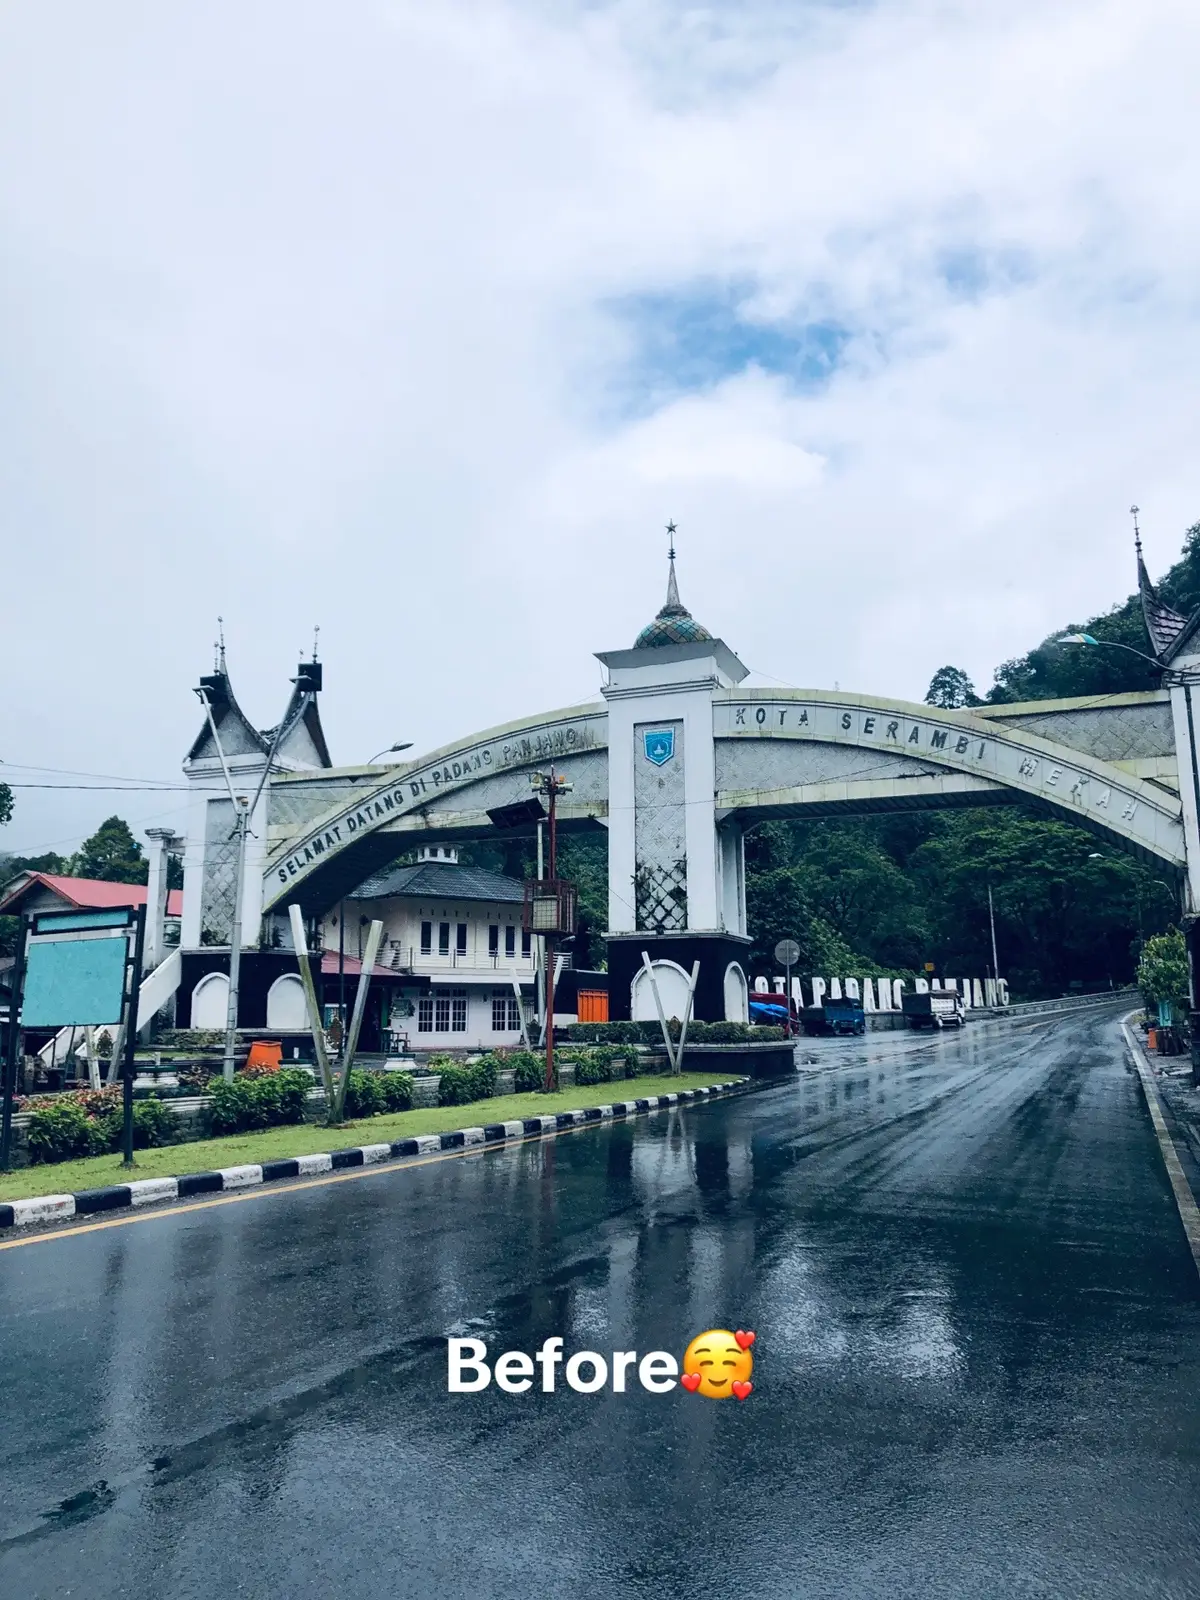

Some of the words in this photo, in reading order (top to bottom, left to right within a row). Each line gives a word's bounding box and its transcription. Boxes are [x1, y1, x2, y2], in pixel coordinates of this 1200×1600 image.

[278, 826, 342, 882] SELAMAT
[346, 790, 404, 832] DATANG
[411, 777, 428, 797] DI
[432, 750, 493, 787] PADANG
[502, 727, 577, 763] PANJANG
[736, 706, 809, 726] KOTA
[841, 712, 985, 760] SERAMBI
[1019, 756, 1138, 820] MEKAH
[748, 975, 804, 1012] OTA
